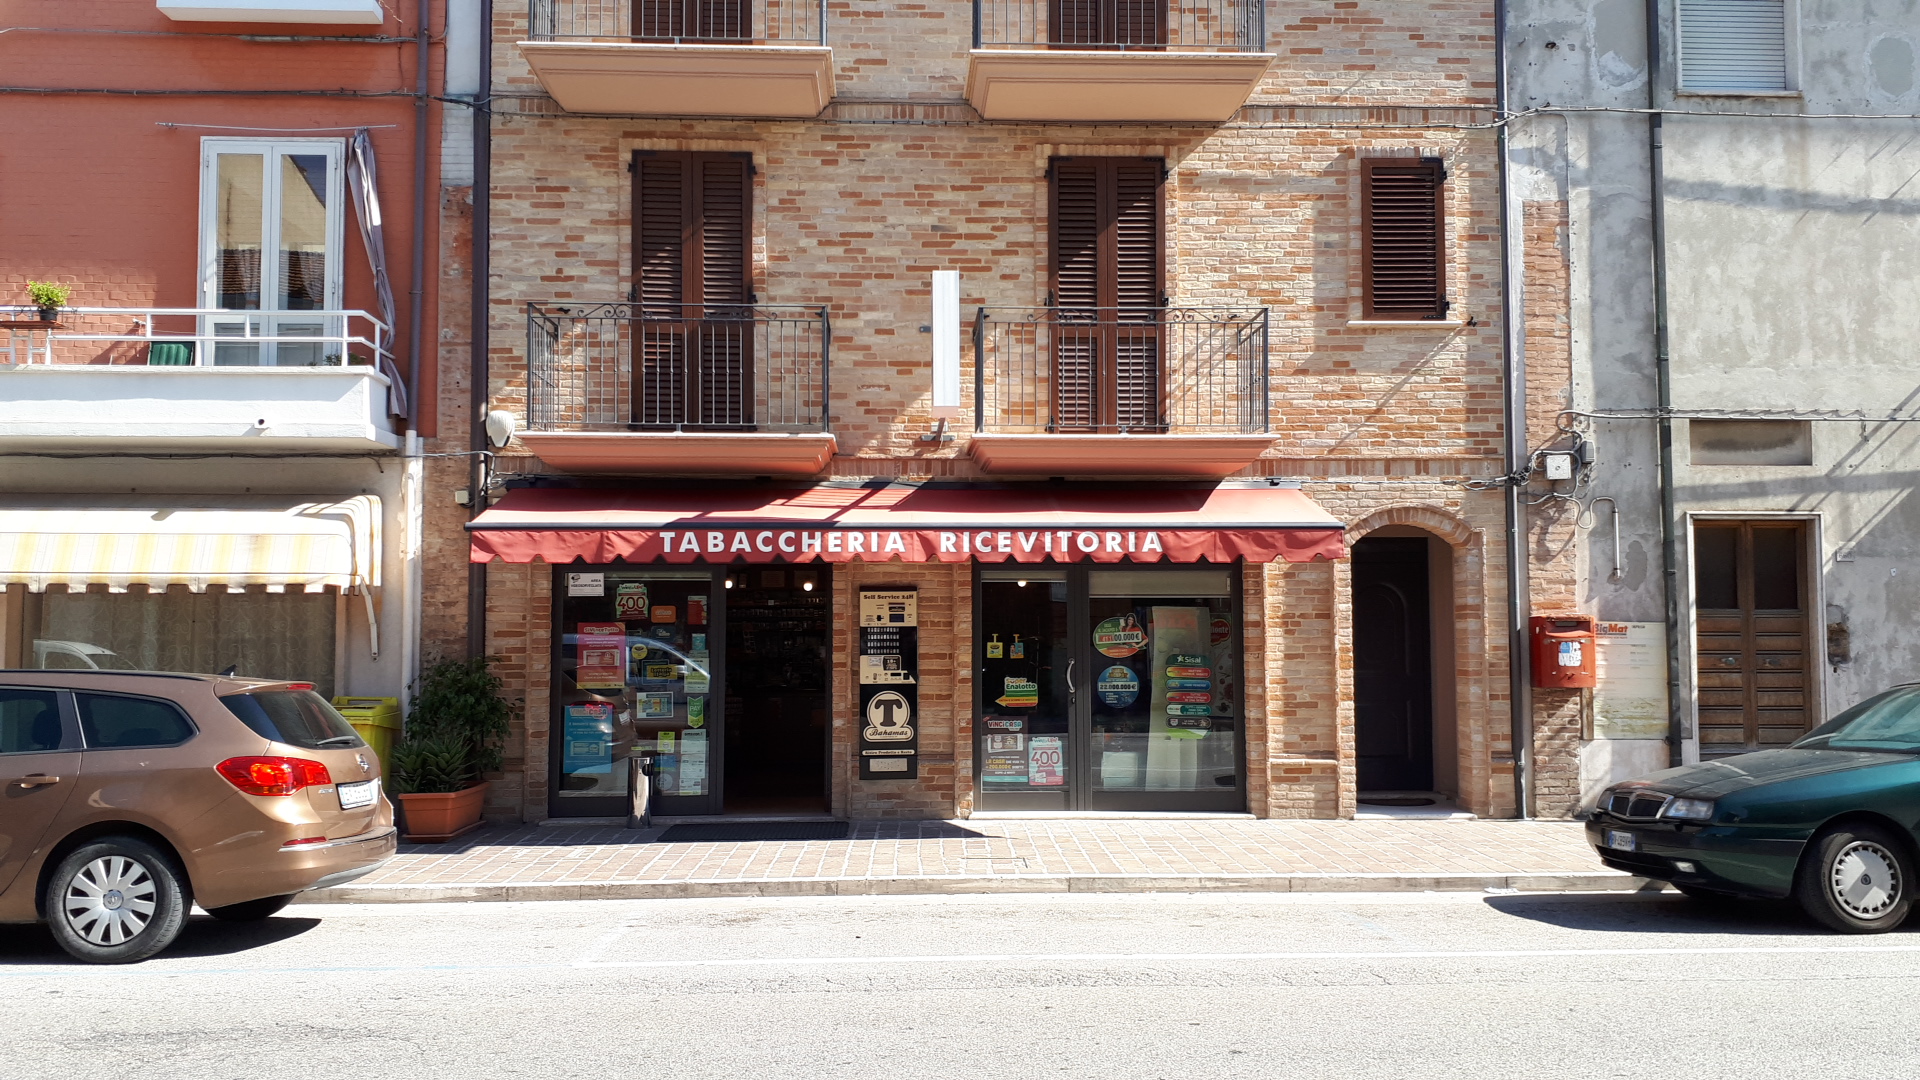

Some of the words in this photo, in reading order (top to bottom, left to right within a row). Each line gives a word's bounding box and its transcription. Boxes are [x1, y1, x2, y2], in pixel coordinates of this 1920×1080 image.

[659, 531, 906, 553] TABACCHERIA
[940, 531, 1163, 553] RICEVITORIA
[617, 596, 646, 610] 400
[874, 698, 903, 727] T
[869, 728, 908, 737] Bahamas
[1031, 751, 1060, 765] 400
